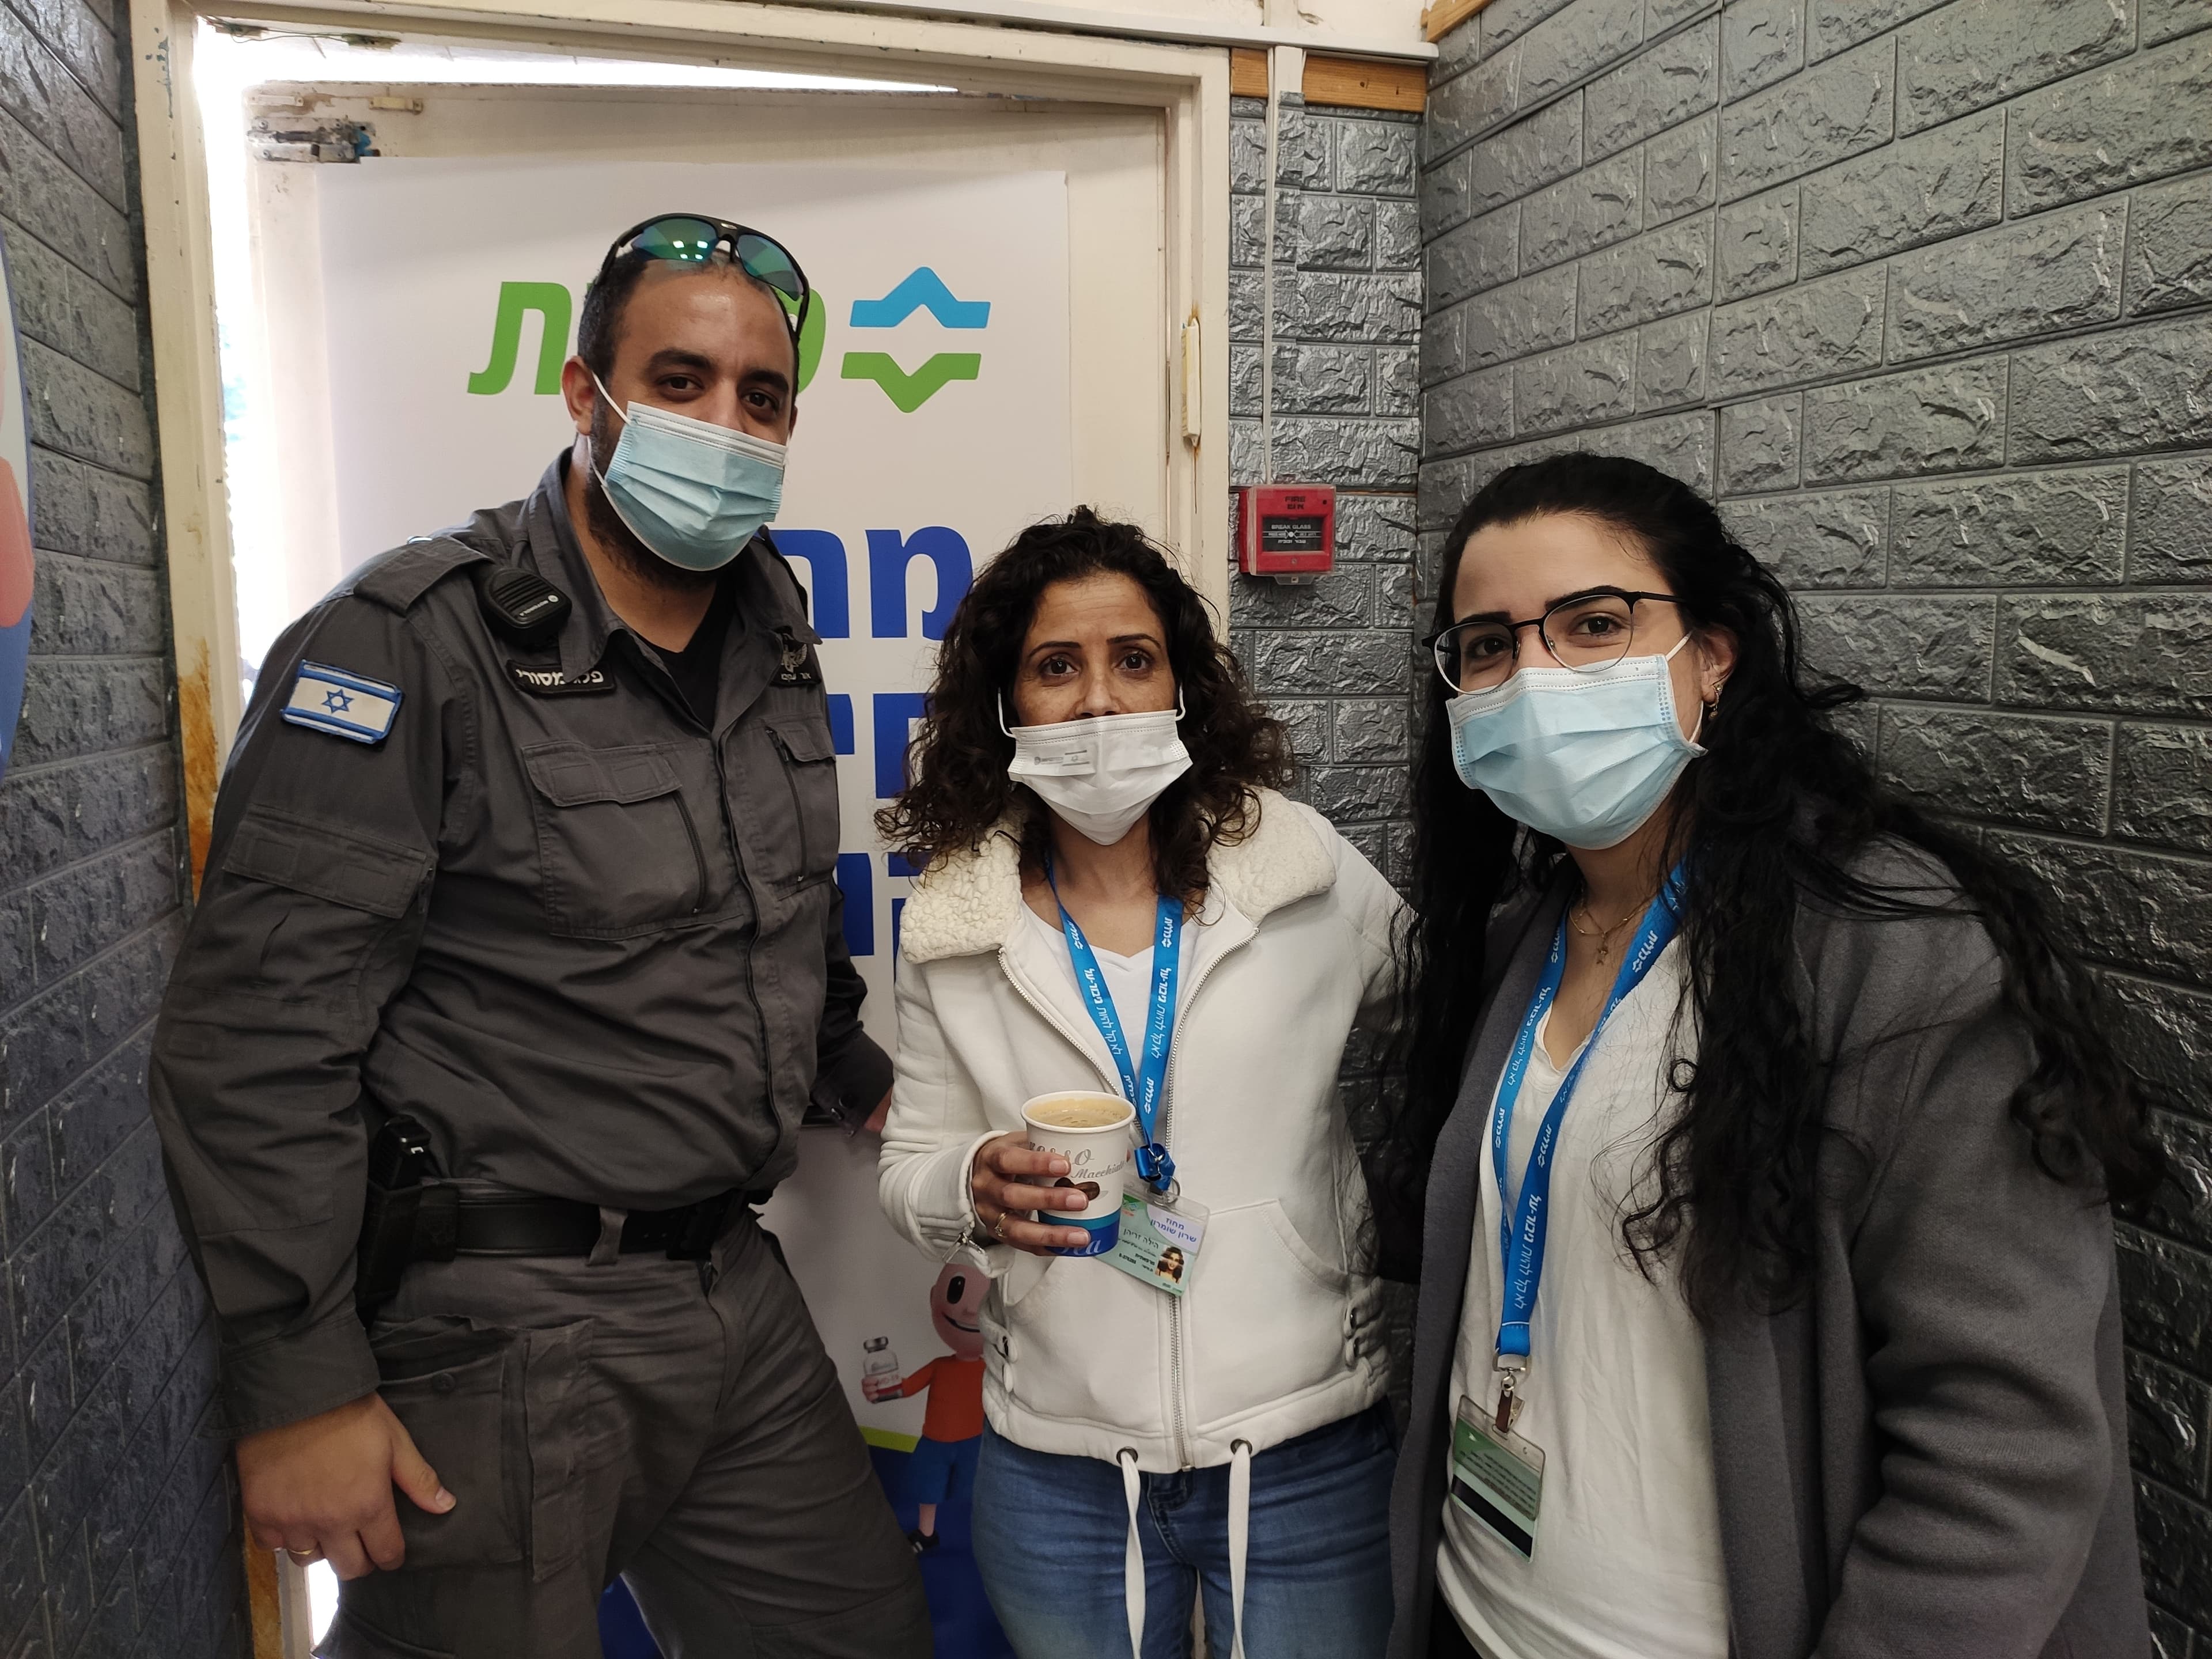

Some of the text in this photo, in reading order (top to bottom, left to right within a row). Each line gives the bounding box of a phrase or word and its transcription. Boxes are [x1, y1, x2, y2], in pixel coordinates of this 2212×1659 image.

[1163, 916, 1173, 938] כללית
[1639, 930, 1658, 959] כללית
[1097, 1006, 1113, 1028] להיות
[1154, 1004, 1166, 1031] להיות
[1105, 1030, 1116, 1043] קל
[1150, 1032, 1165, 1045] קל
[1110, 1043, 1123, 1055] לא
[1151, 1044, 1162, 1059] לא
[1508, 1073, 1516, 1086] לא
[1512, 1058, 1522, 1071] קל
[1518, 1031, 1528, 1056] להיות
[1145, 1076, 1154, 1103] כללית
[1496, 1107, 1505, 1135] כללית
[1540, 1123, 1552, 1154] כללית
[1150, 1219, 1196, 1242] שרון שומרון
[1166, 1217, 1184, 1230] מחוז
[1514, 1194, 1542, 1309] לא קל להיות גיבור-על
